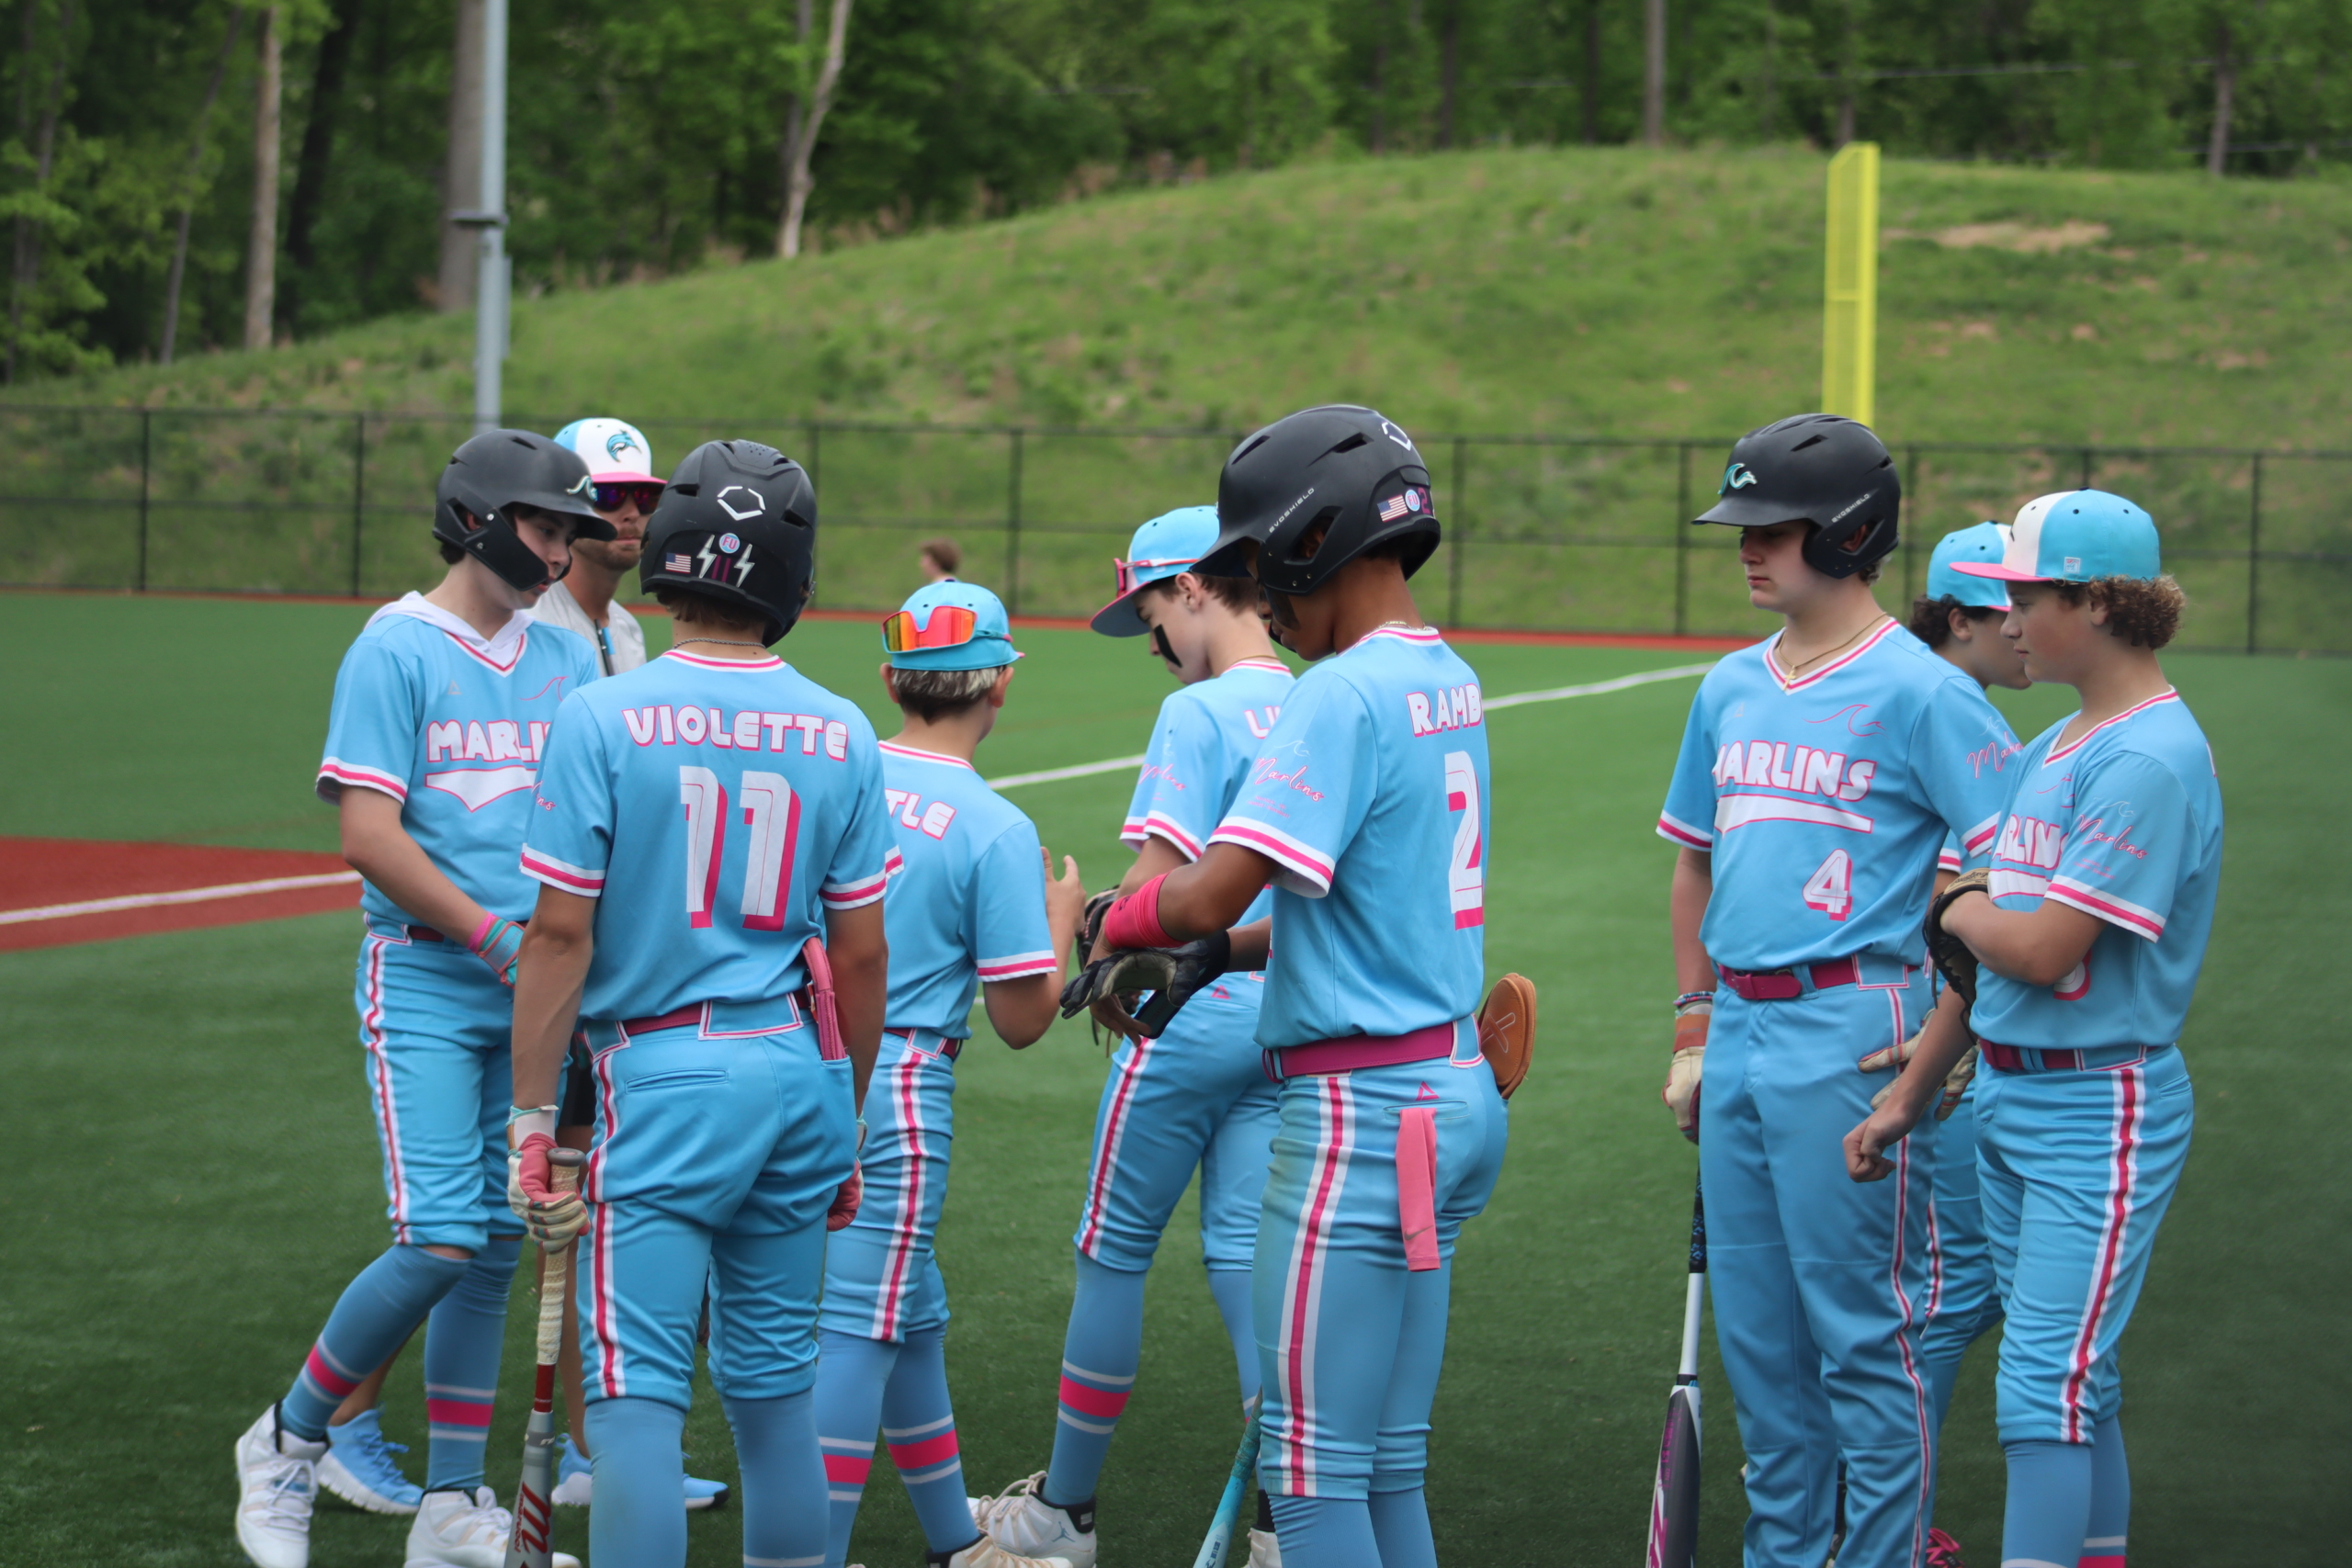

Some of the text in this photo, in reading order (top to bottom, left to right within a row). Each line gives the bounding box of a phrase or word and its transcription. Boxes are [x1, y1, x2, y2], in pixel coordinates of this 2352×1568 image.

[1268, 487, 1315, 534] EVOSHIELD
[1407, 493, 1419, 507] FU
[721, 536, 738, 550] FU
[621, 704, 848, 762] VIOLETTE
[1252, 757, 1325, 802] Marlins
[678, 764, 802, 932] 11
[1443, 750, 1485, 931] 2
[2074, 814, 2148, 860] Marlins
[1801, 848, 1853, 922] 4
